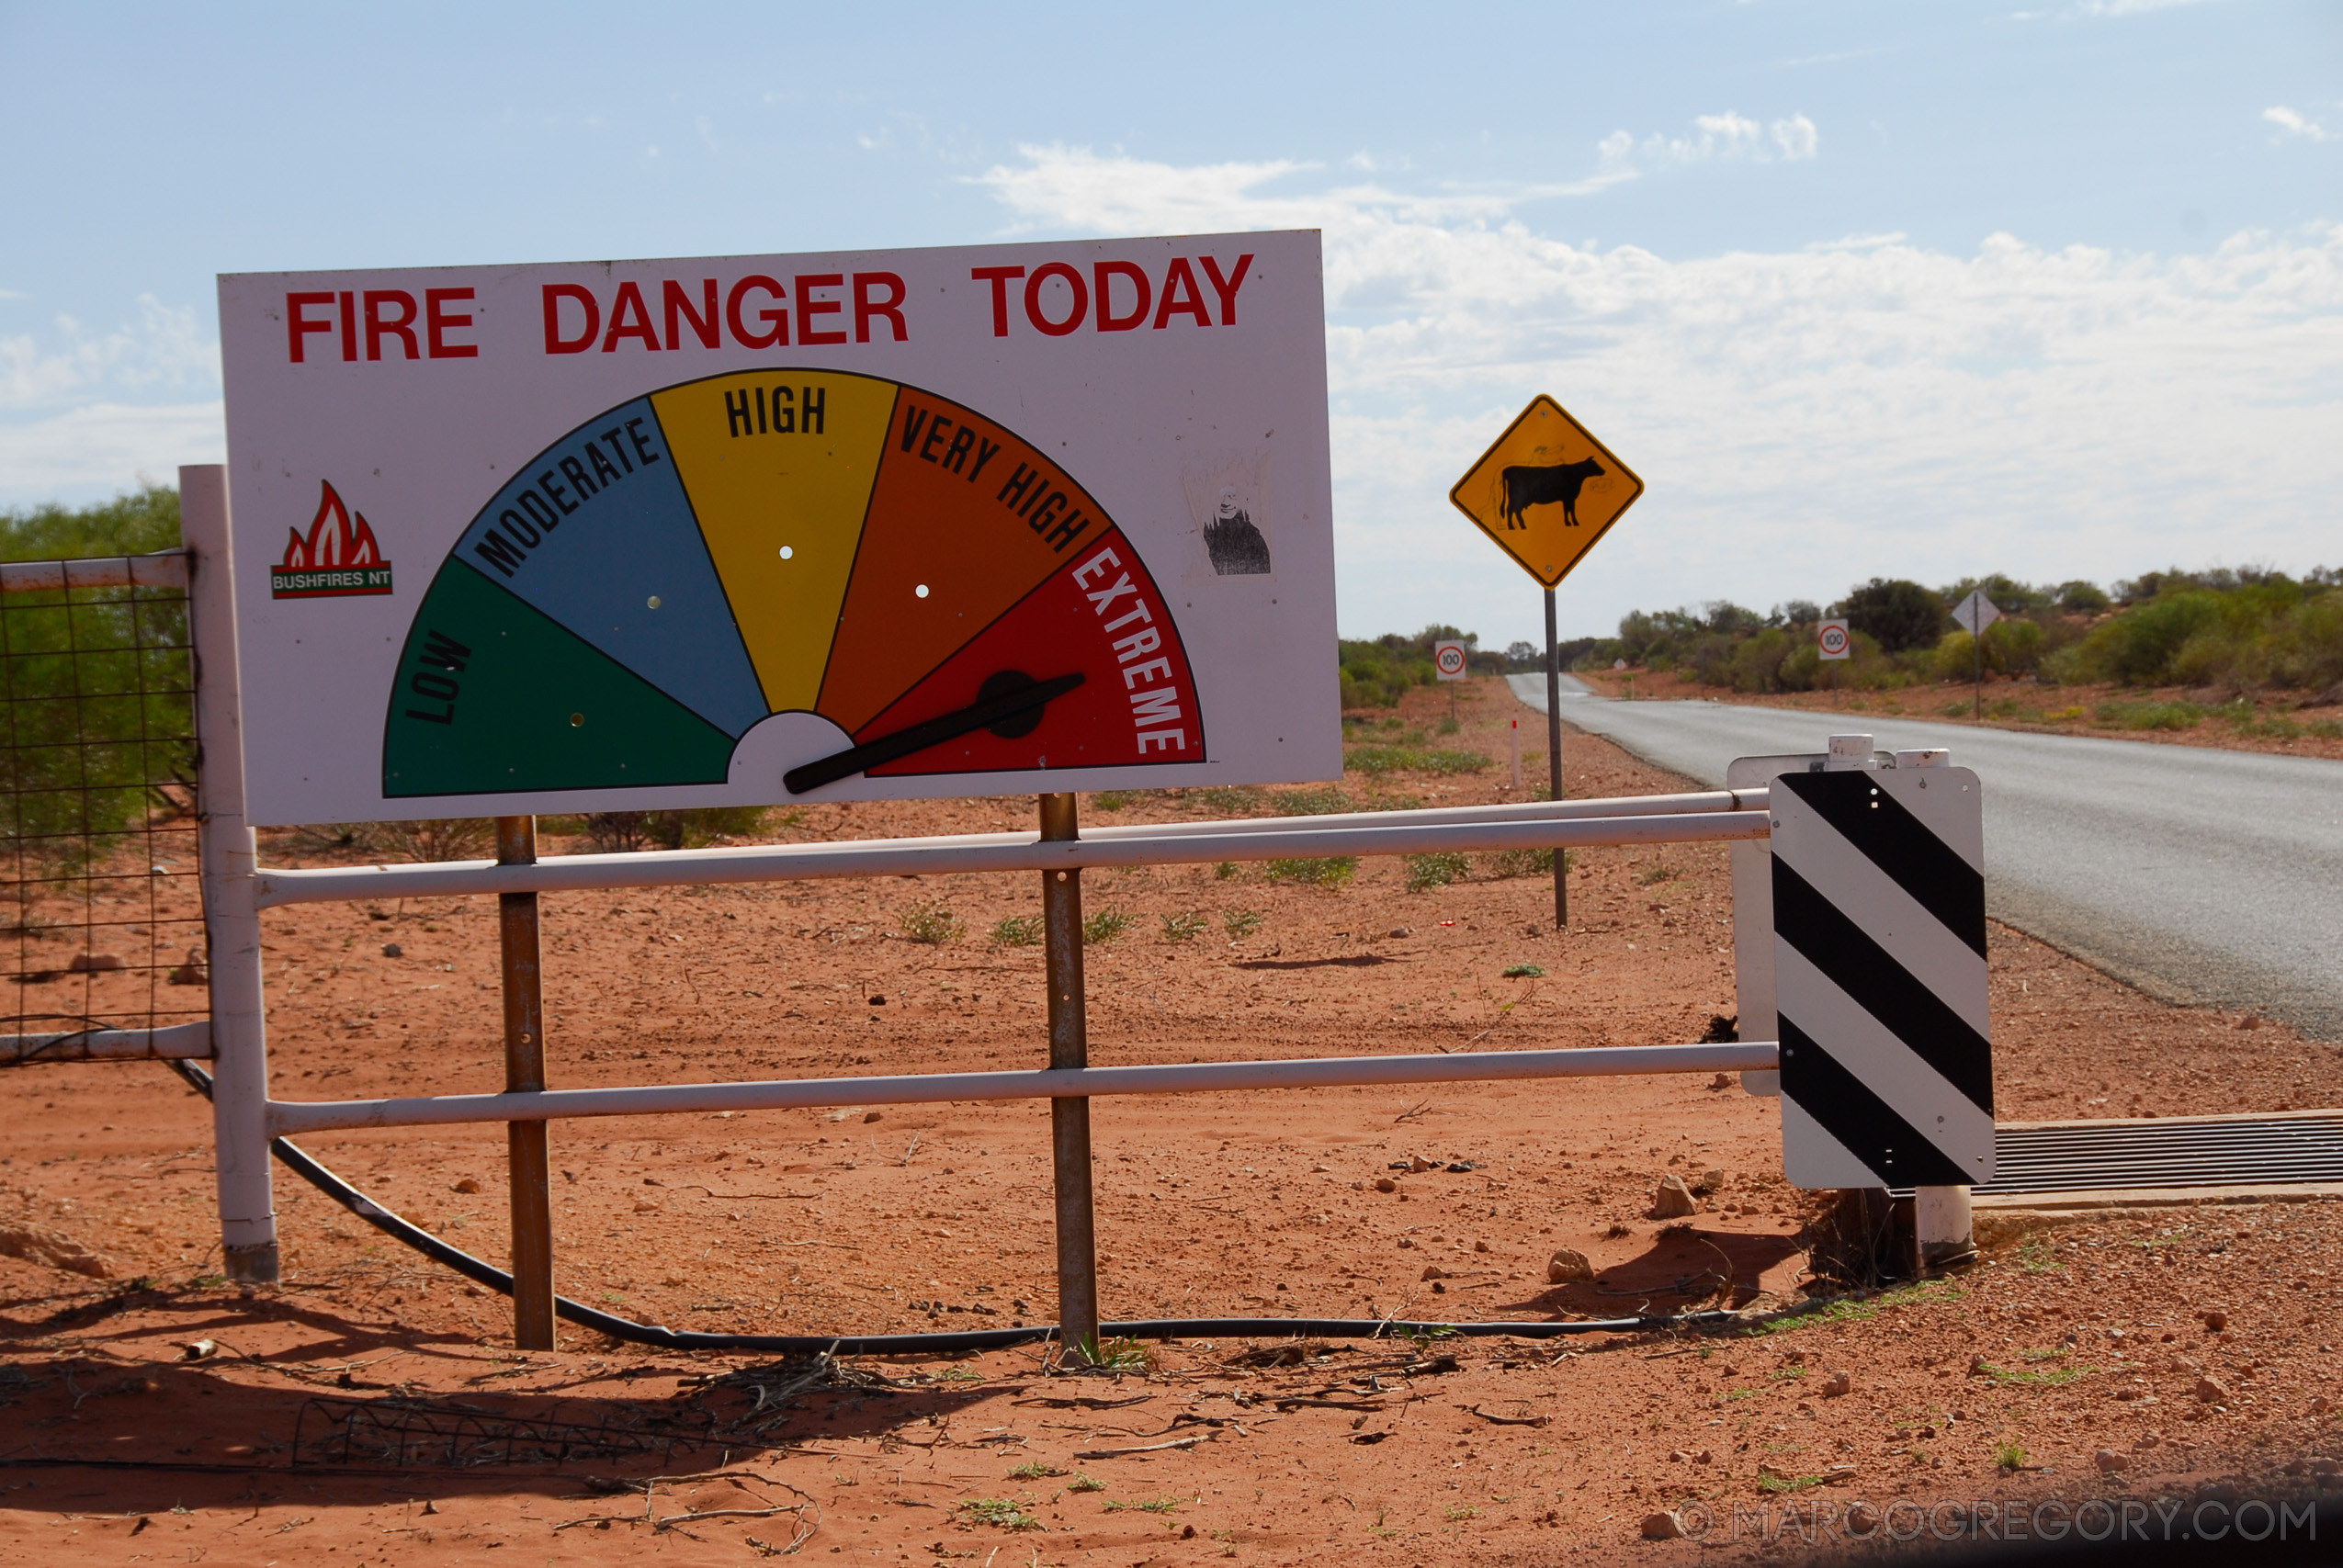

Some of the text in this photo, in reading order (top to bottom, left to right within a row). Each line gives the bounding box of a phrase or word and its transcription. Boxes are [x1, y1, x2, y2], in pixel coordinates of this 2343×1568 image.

[286, 253, 1255, 363] FIRE DANGER TODAY
[723, 385, 826, 438] HIGH
[474, 417, 660, 578] MODERATE
[900, 404, 1092, 554] VERY HIGH
[273, 570, 390, 590] BUSHFIRES NT
[405, 628, 472, 726] LOW
[1071, 547, 1186, 755] EXTREME
[1443, 654, 1460, 665] 100
[1825, 634, 1843, 645] 100
